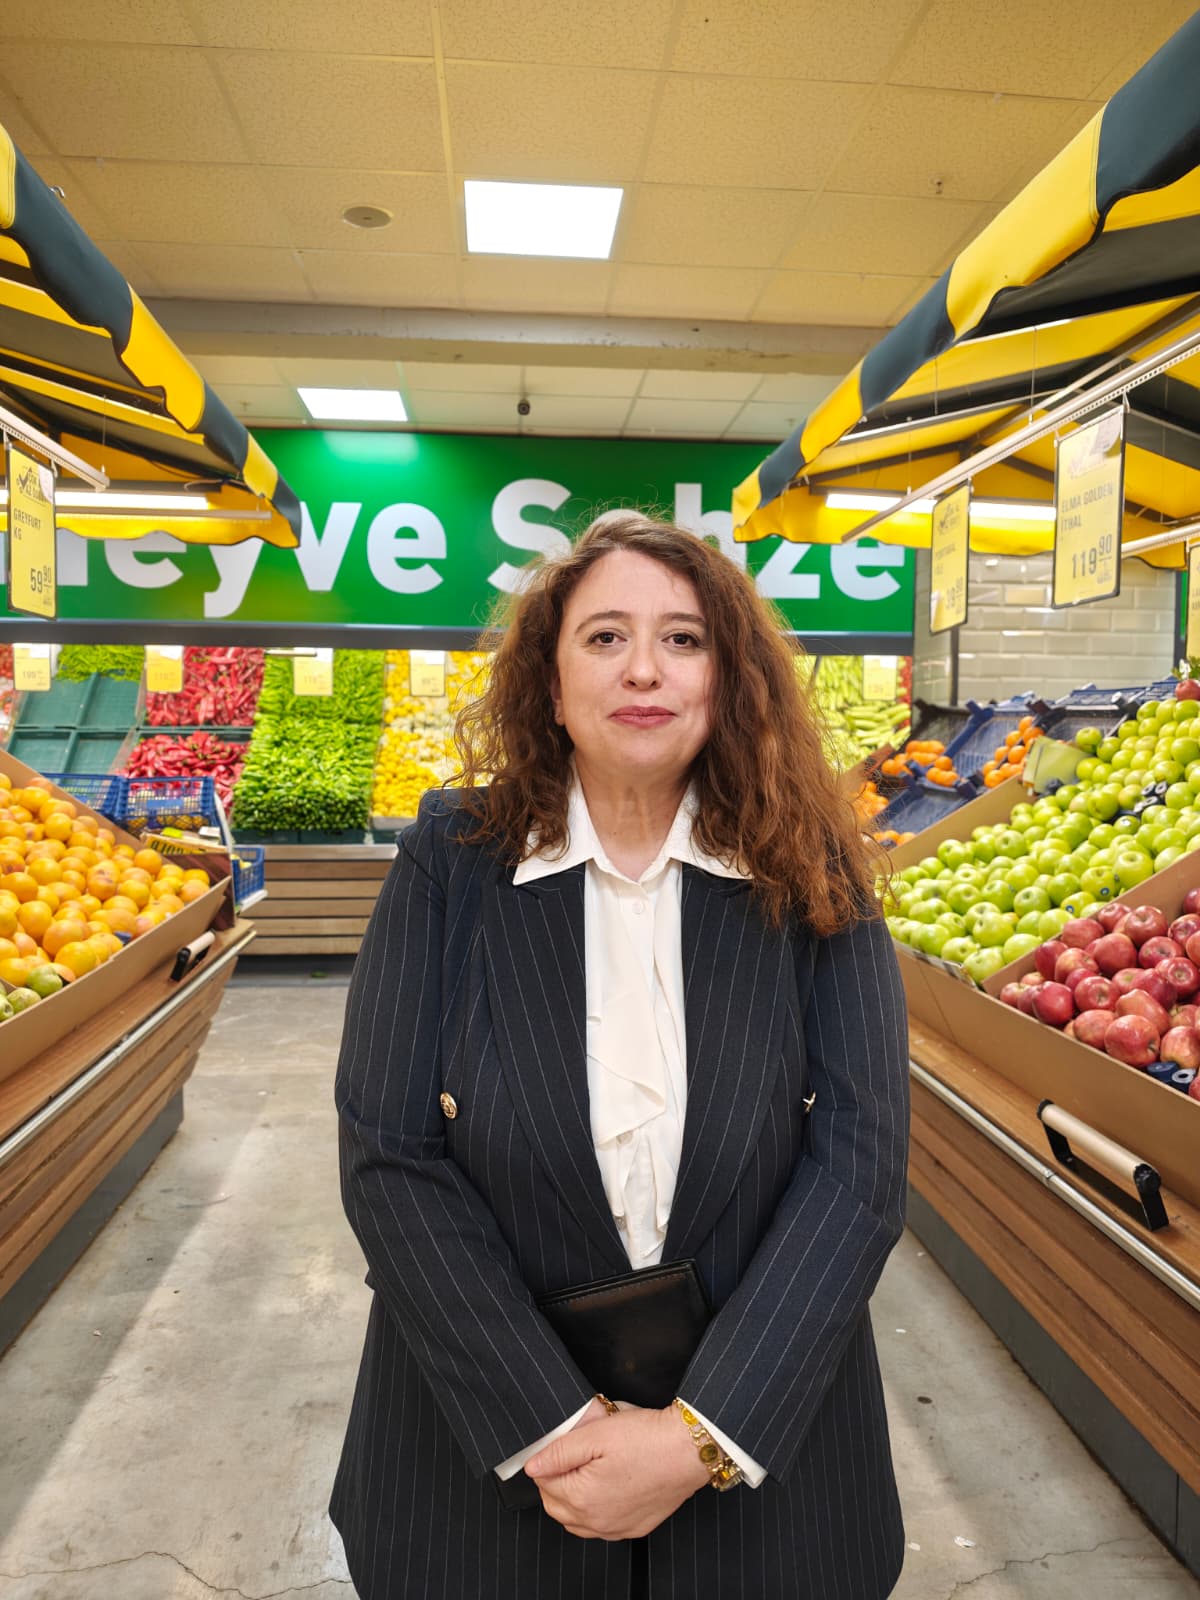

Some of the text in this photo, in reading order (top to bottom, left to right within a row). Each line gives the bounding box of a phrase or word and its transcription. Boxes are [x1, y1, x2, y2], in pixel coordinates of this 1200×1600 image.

[1062, 482, 1112, 513] ELMA GOLDEN
[14, 508, 41, 530] GREYFURT
[14, 526, 23, 541] KG
[0, 502, 447, 618] eyve
